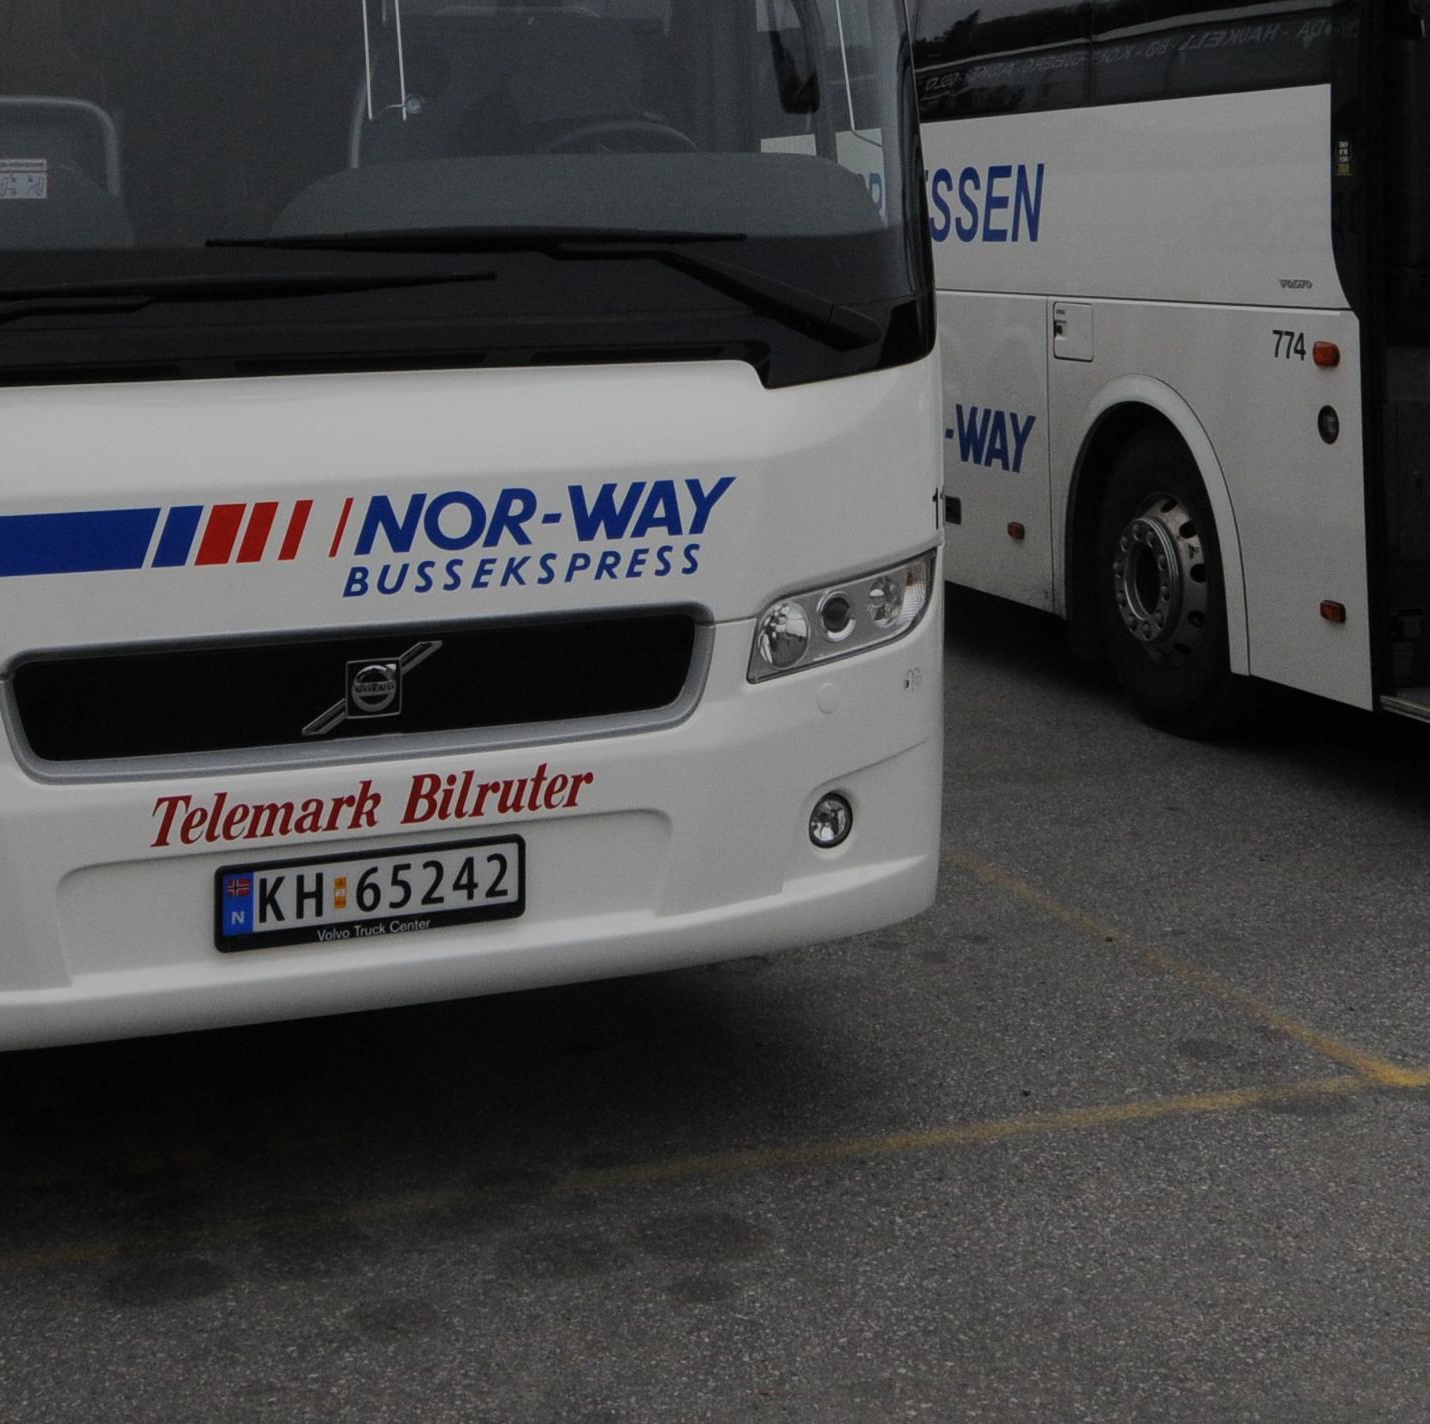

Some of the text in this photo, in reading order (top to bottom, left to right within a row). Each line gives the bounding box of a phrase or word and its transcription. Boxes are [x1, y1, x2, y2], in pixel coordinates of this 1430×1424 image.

[924, 163, 1045, 243] SSEN
[1272, 329, 1307, 361] 774
[353, 477, 737, 556] NOR-WAY
[342, 543, 701, 598] BUSSEKSPRESS
[150, 762, 594, 848] Telemark Bilruter
[231, 911, 245, 925] N
[258, 852, 509, 924] KH 65242
[317, 918, 431, 942] Volvo Truck Center
